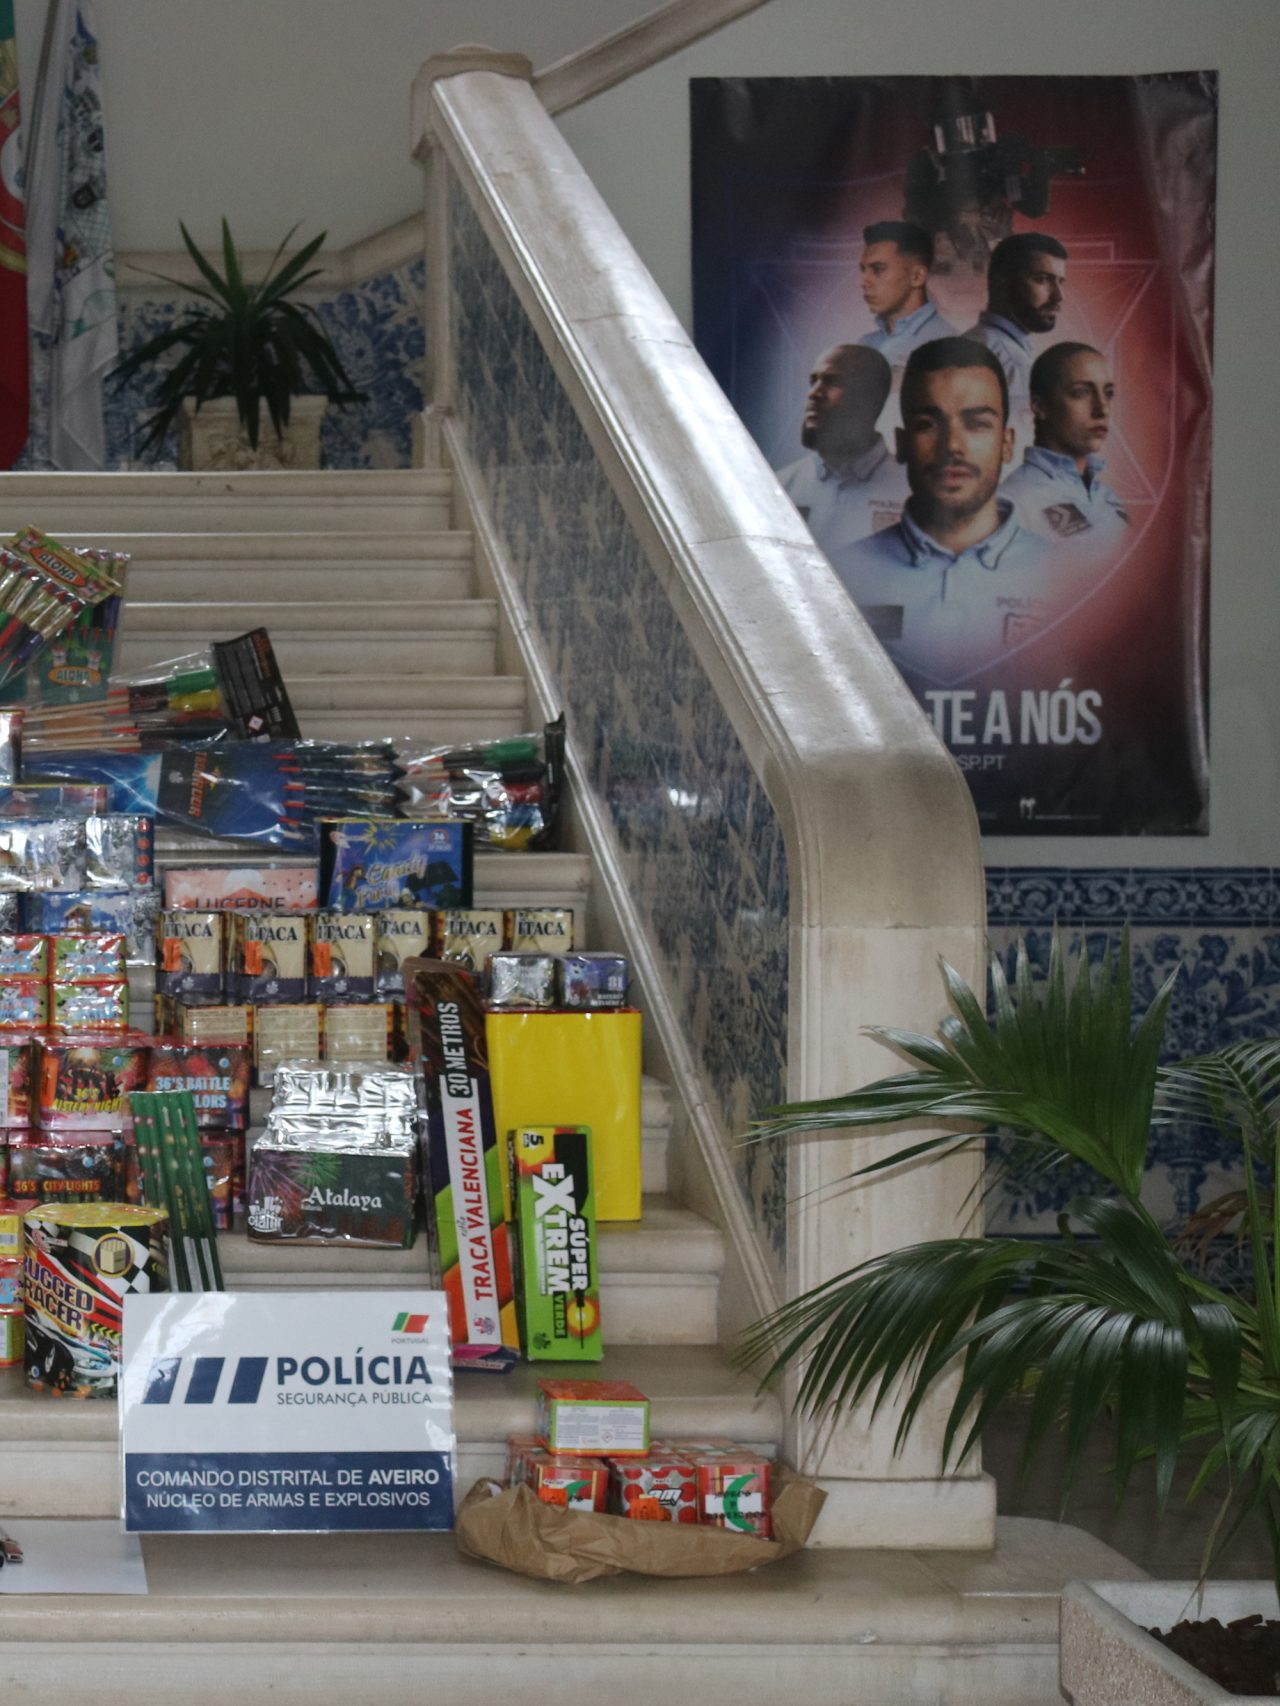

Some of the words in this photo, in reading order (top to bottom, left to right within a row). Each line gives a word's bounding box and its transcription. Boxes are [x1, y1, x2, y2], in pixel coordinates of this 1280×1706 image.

[38, 552, 77, 582] ALOHA
[57, 670, 93, 682] ALOHA
[983, 689, 1012, 745] A
[1020, 678, 1103, 746] NÓS
[957, 754, 1006, 771] SP.PT
[165, 923, 213, 938] ITACA
[318, 924, 367, 940] ITACA
[450, 921, 497, 936] ITACA
[518, 921, 565, 936] ITACA
[437, 1002, 467, 1070] METROS
[156, 1077, 184, 1091] 36'S
[186, 1076, 230, 1091] BATTLE
[448, 1072, 471, 1096] 30
[195, 1094, 226, 1109] LORS
[531, 1134, 544, 1146] 5
[451, 1107, 483, 1230] VALENCIANA
[43, 1180, 64, 1192] CITY
[65, 1180, 101, 1193] LIGHTS
[309, 1186, 383, 1211] Atalaya
[470, 1235, 494, 1302] TRACA
[554, 1295, 566, 1336] VERDE
[391, 1337, 430, 1345] PORTUGAL
[277, 1347, 433, 1386] POLÍCIA
[277, 1392, 367, 1408] SEGURANÇA
[372, 1389, 432, 1405] PÚBLICA
[136, 1470, 235, 1487] COMANDO
[239, 1470, 332, 1486] DISTRITAL
[338, 1470, 363, 1485] DE
[368, 1469, 440, 1485] AVEIRO
[147, 1489, 215, 1508] NÚCLEO
[219, 1493, 242, 1508] DE
[245, 1493, 305, 1507] ARMAS
[310, 1493, 320, 1507] E
[325, 1492, 431, 1507] EXPLOSIVOS
